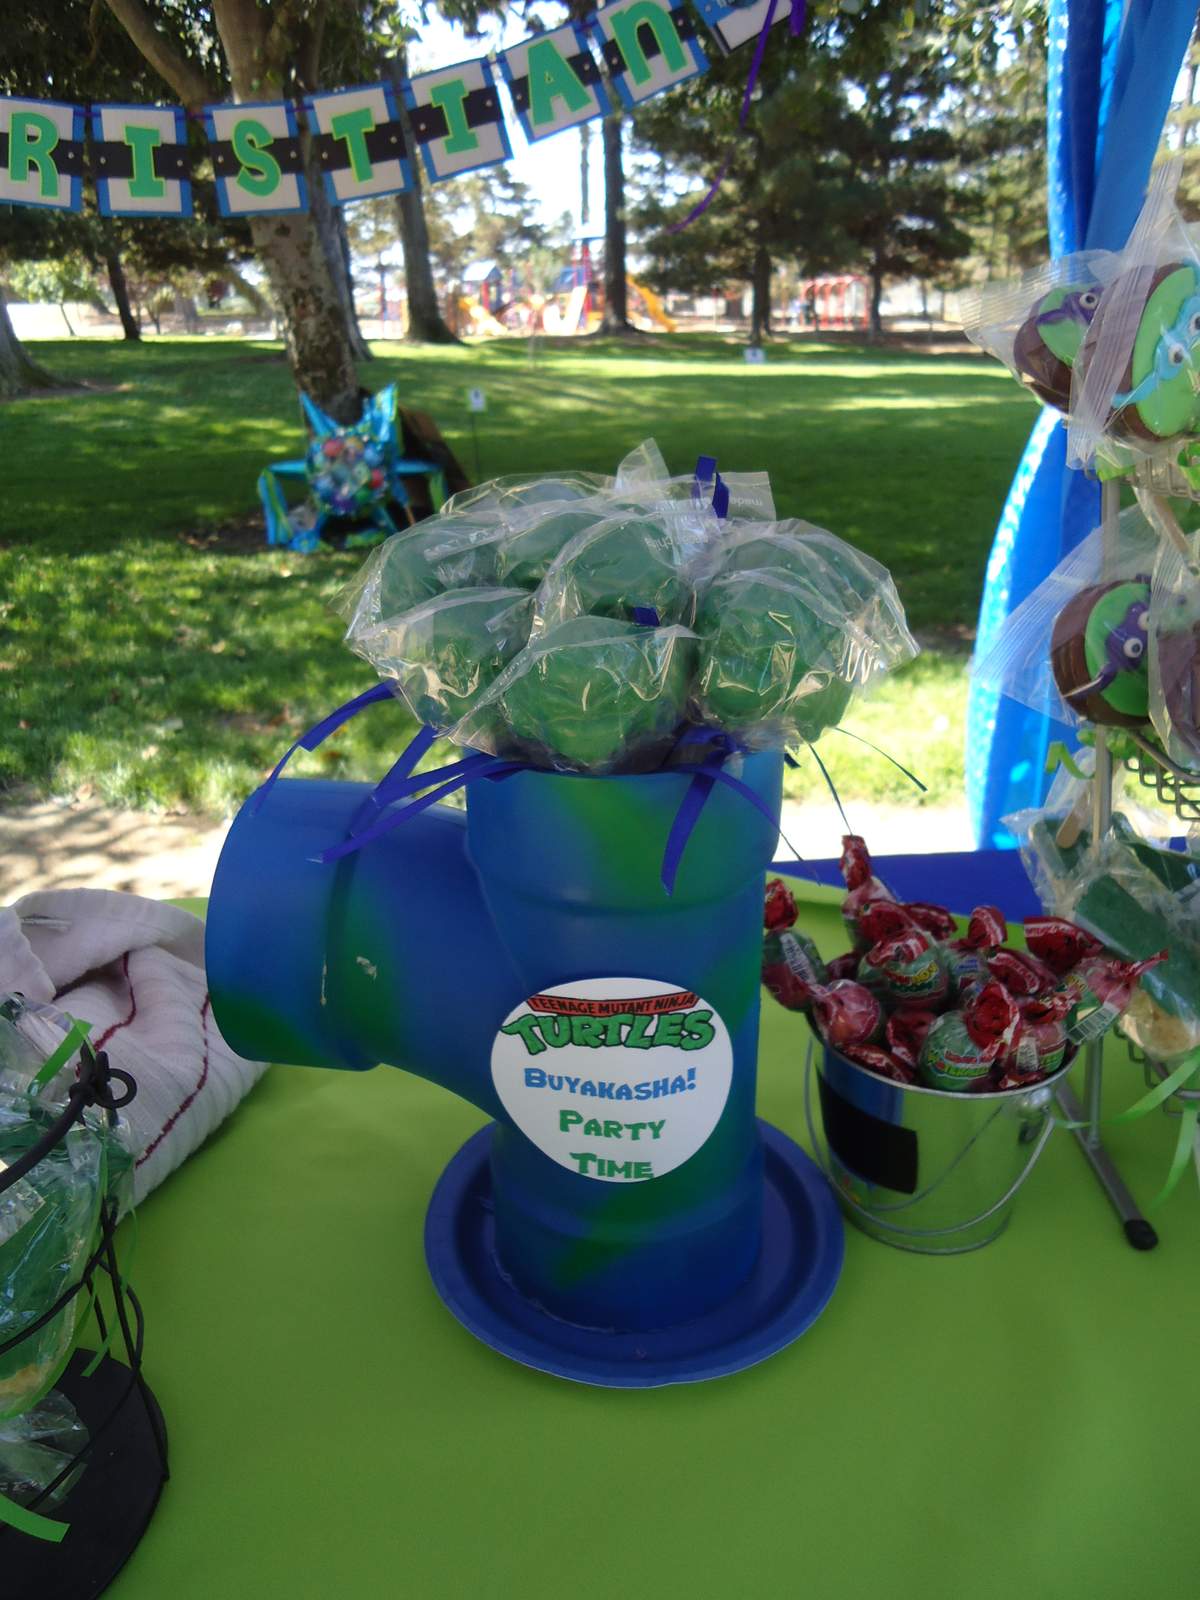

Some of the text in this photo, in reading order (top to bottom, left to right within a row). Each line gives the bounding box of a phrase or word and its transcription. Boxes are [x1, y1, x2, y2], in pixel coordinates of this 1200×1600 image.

[532, 992, 695, 1014] TEENAGE MUTANT NINJA
[501, 1010, 716, 1056] TURTLES
[558, 1109, 667, 1141] PARTY
[569, 1152, 654, 1179] TIME
